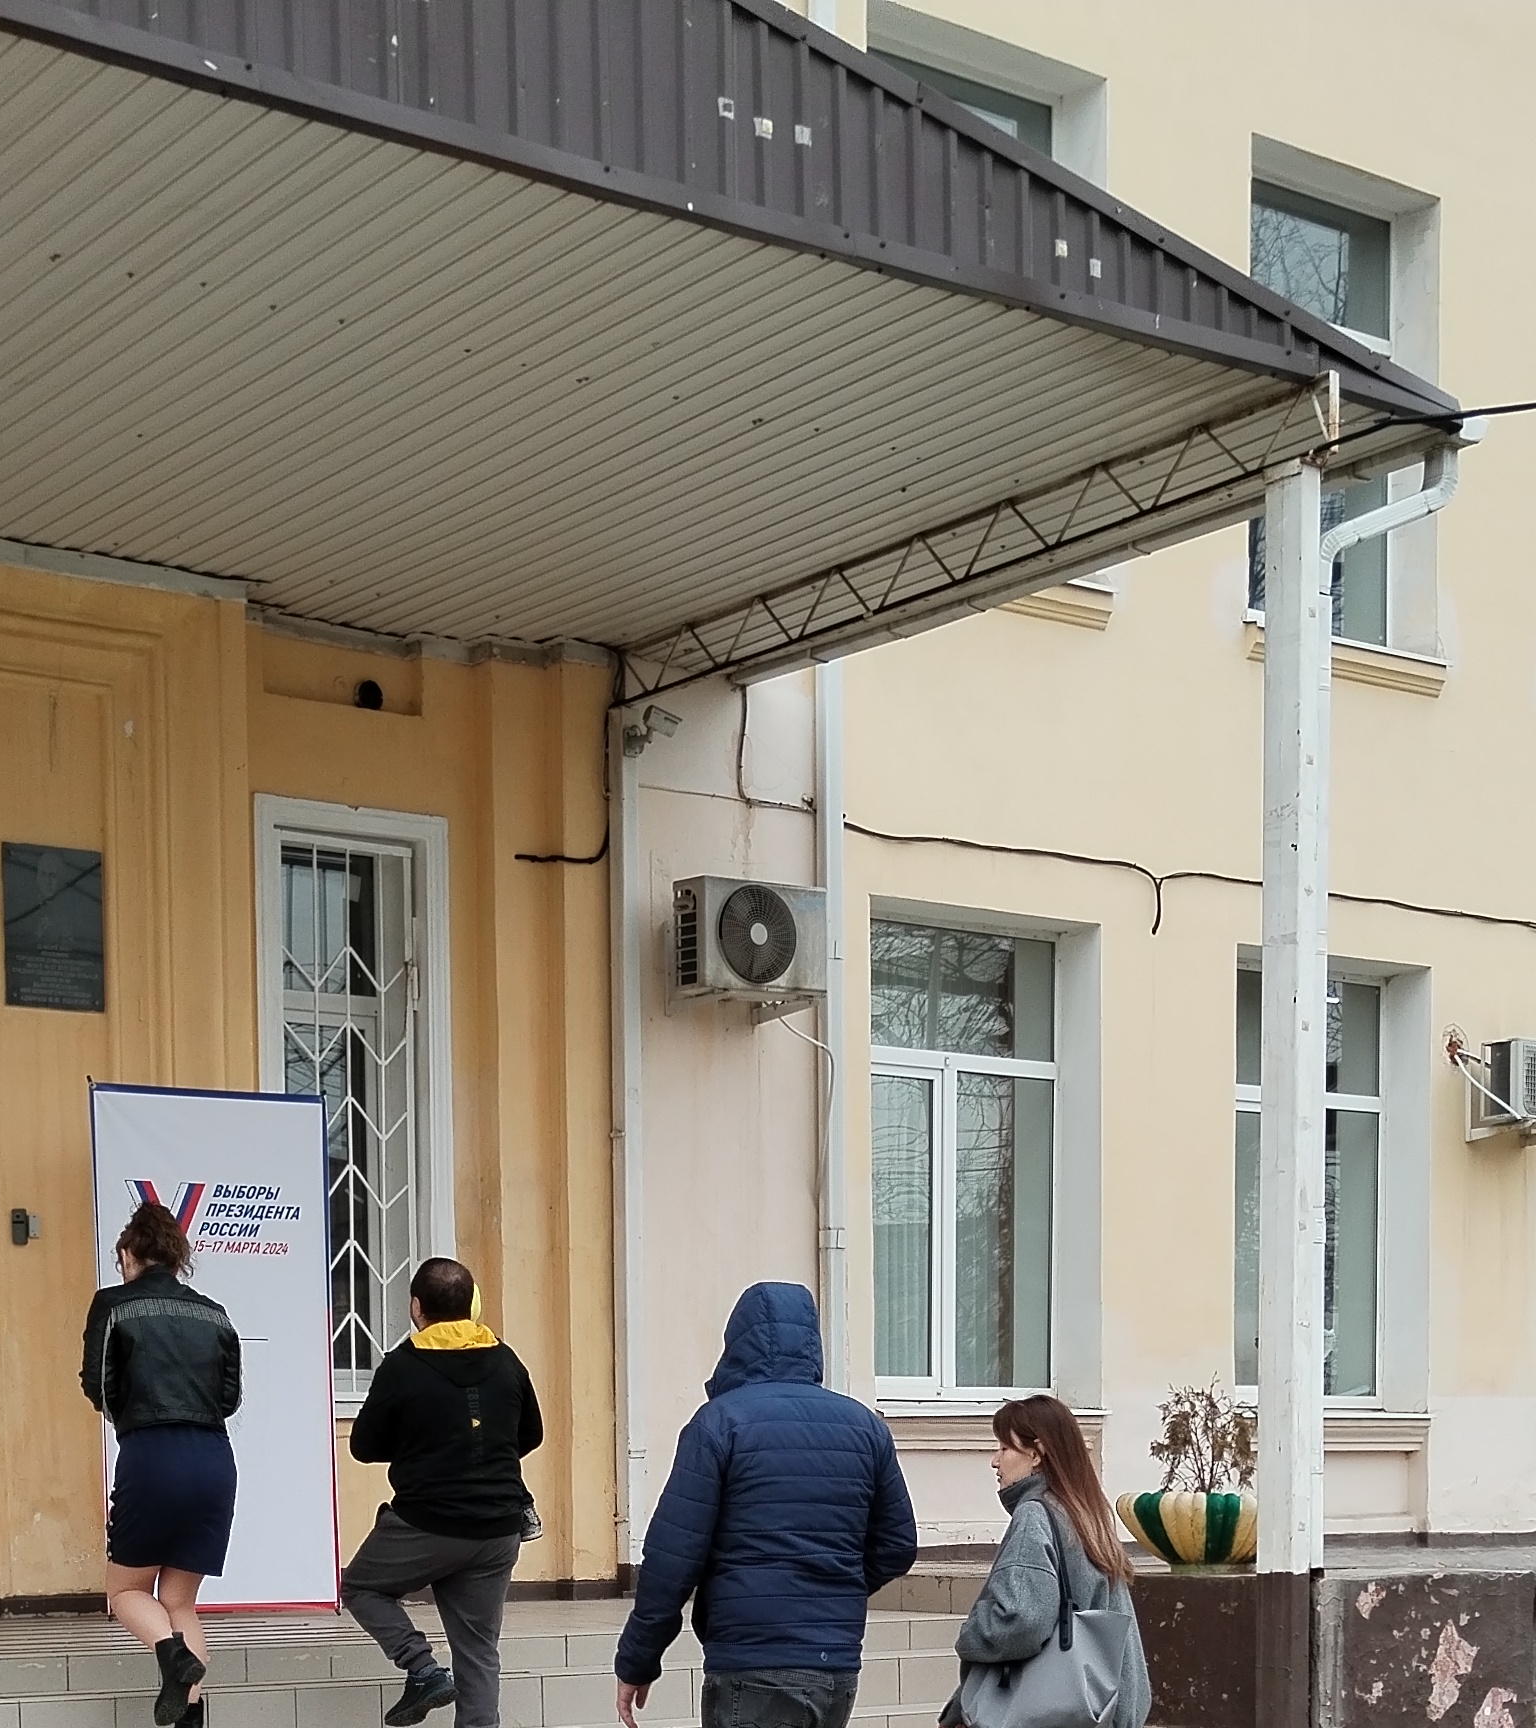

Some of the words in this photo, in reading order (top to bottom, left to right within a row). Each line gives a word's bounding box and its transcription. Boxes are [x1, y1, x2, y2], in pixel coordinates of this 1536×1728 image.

[212, 1184, 281, 1200] ВЫБОРЫ
[205, 1203, 300, 1220] ПРЕЗИДЕНТА
[198, 1222, 261, 1238] РОССИИ
[224, 1241, 261, 1255] МАРТА
[262, 1243, 289, 1255] 2024
